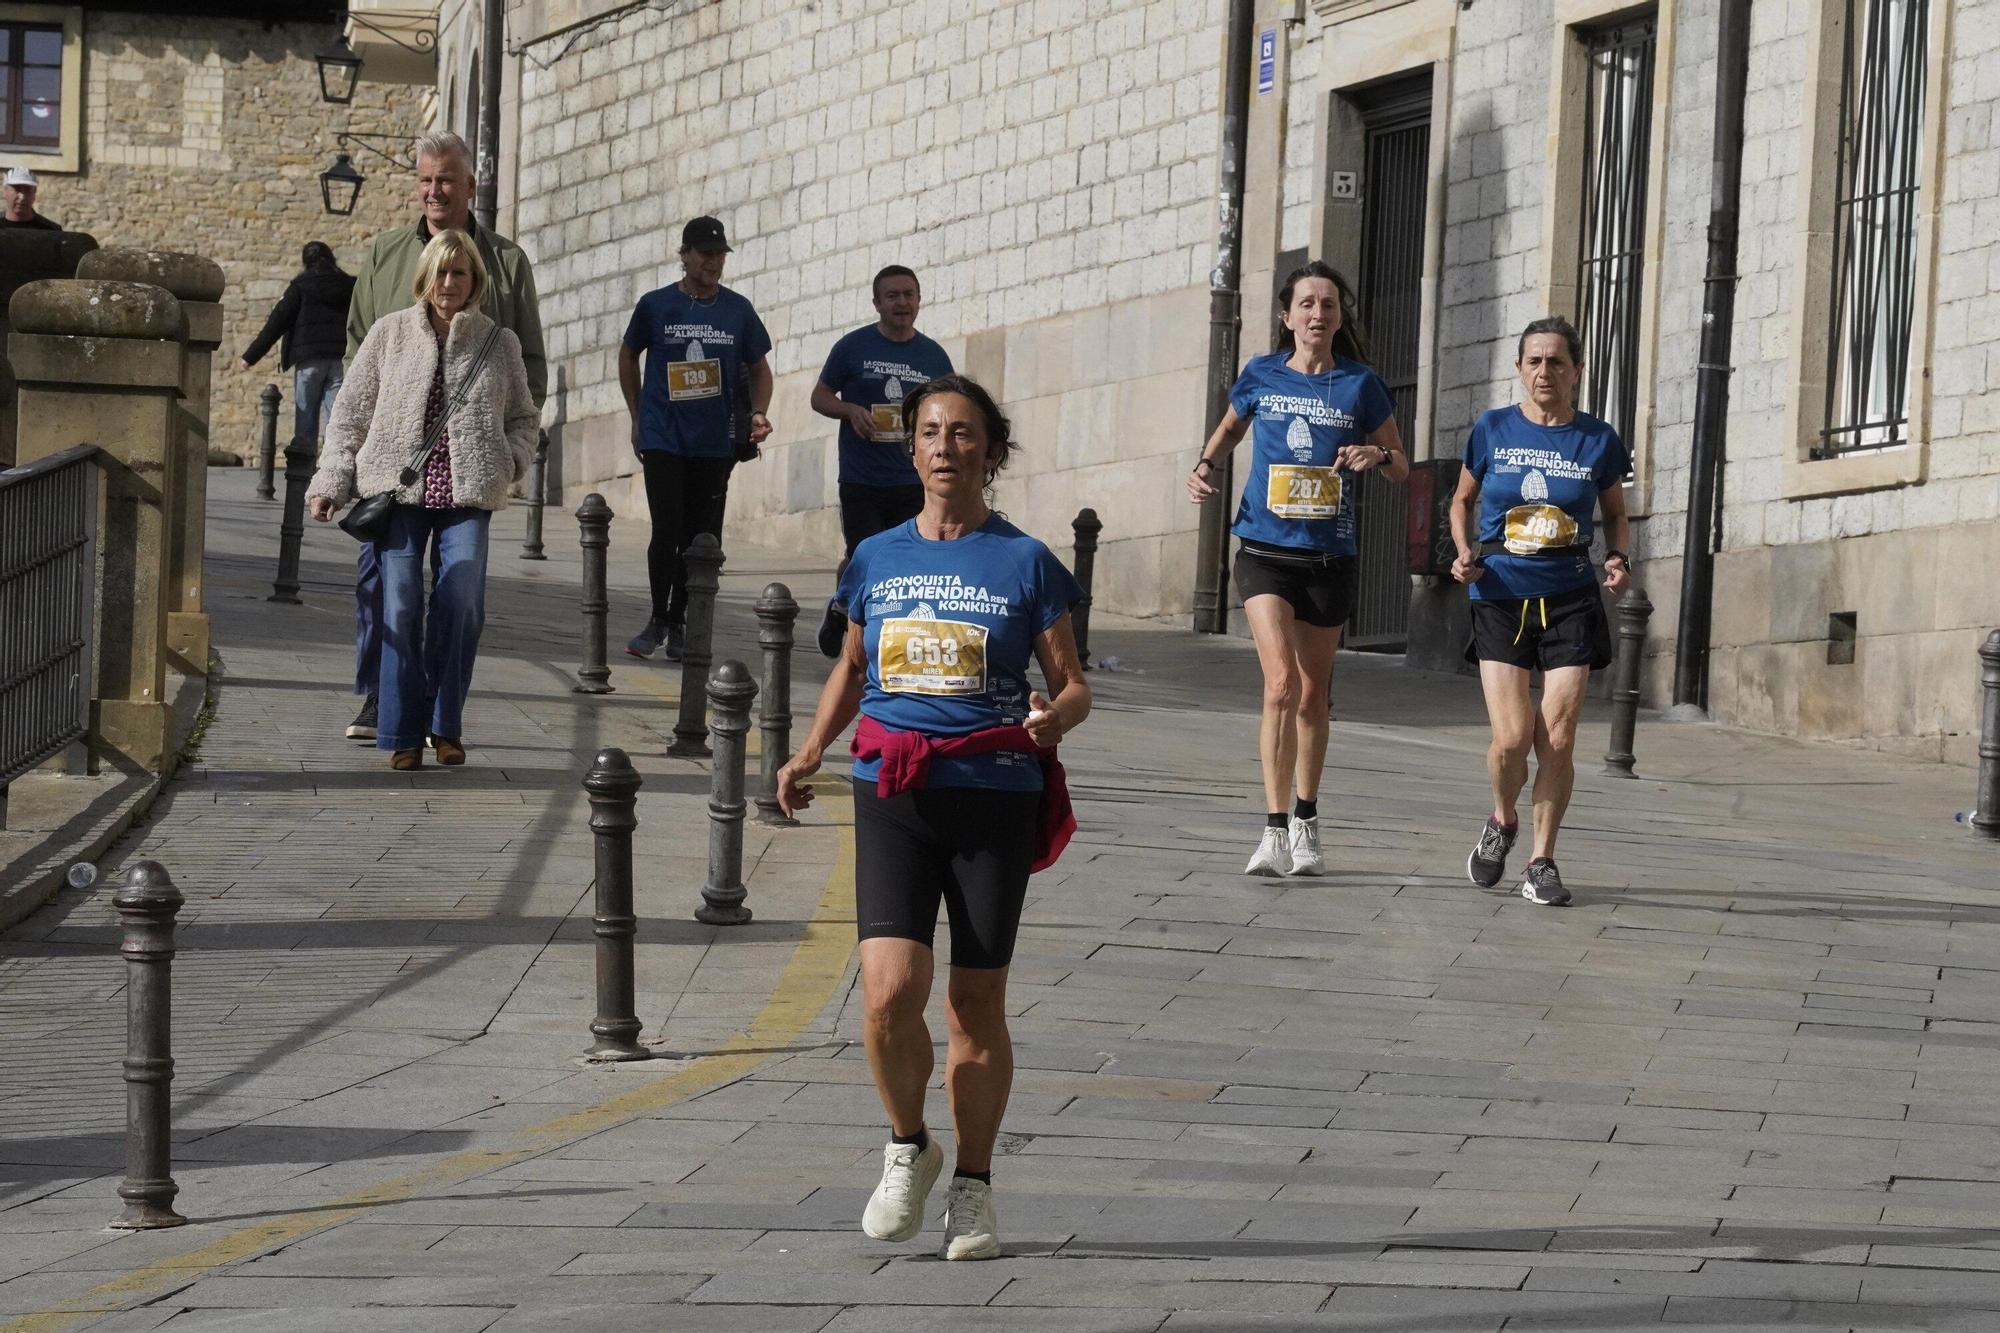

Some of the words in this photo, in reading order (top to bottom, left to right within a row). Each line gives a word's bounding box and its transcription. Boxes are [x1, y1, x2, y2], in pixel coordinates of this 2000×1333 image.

[674, 330, 727, 338] ALMENDRA
[872, 360, 911, 370] CONQUISTA
[682, 370, 707, 386] 139
[873, 366, 922, 379] ALMENDRA
[1270, 394, 1324, 407] CONQUISTA
[1271, 402, 1342, 419] ALMENDRA
[1309, 416, 1353, 429] KONKISTA
[1507, 448, 1562, 460] CONQUISTA
[1507, 456, 1580, 472] ALMENDRA
[1546, 468, 1592, 481] KONKISTA
[1289, 479, 1322, 499] 287
[872, 582, 885, 592] LA
[884, 575, 962, 590] CONQUISTA
[872, 591, 880, 599] DE
[886, 586, 990, 601] ALMENDRA
[990, 595, 1009, 604] REN
[938, 600, 1009, 617] KONKISTA
[906, 636, 959, 666] 653
[922, 667, 944, 675] MIREN
